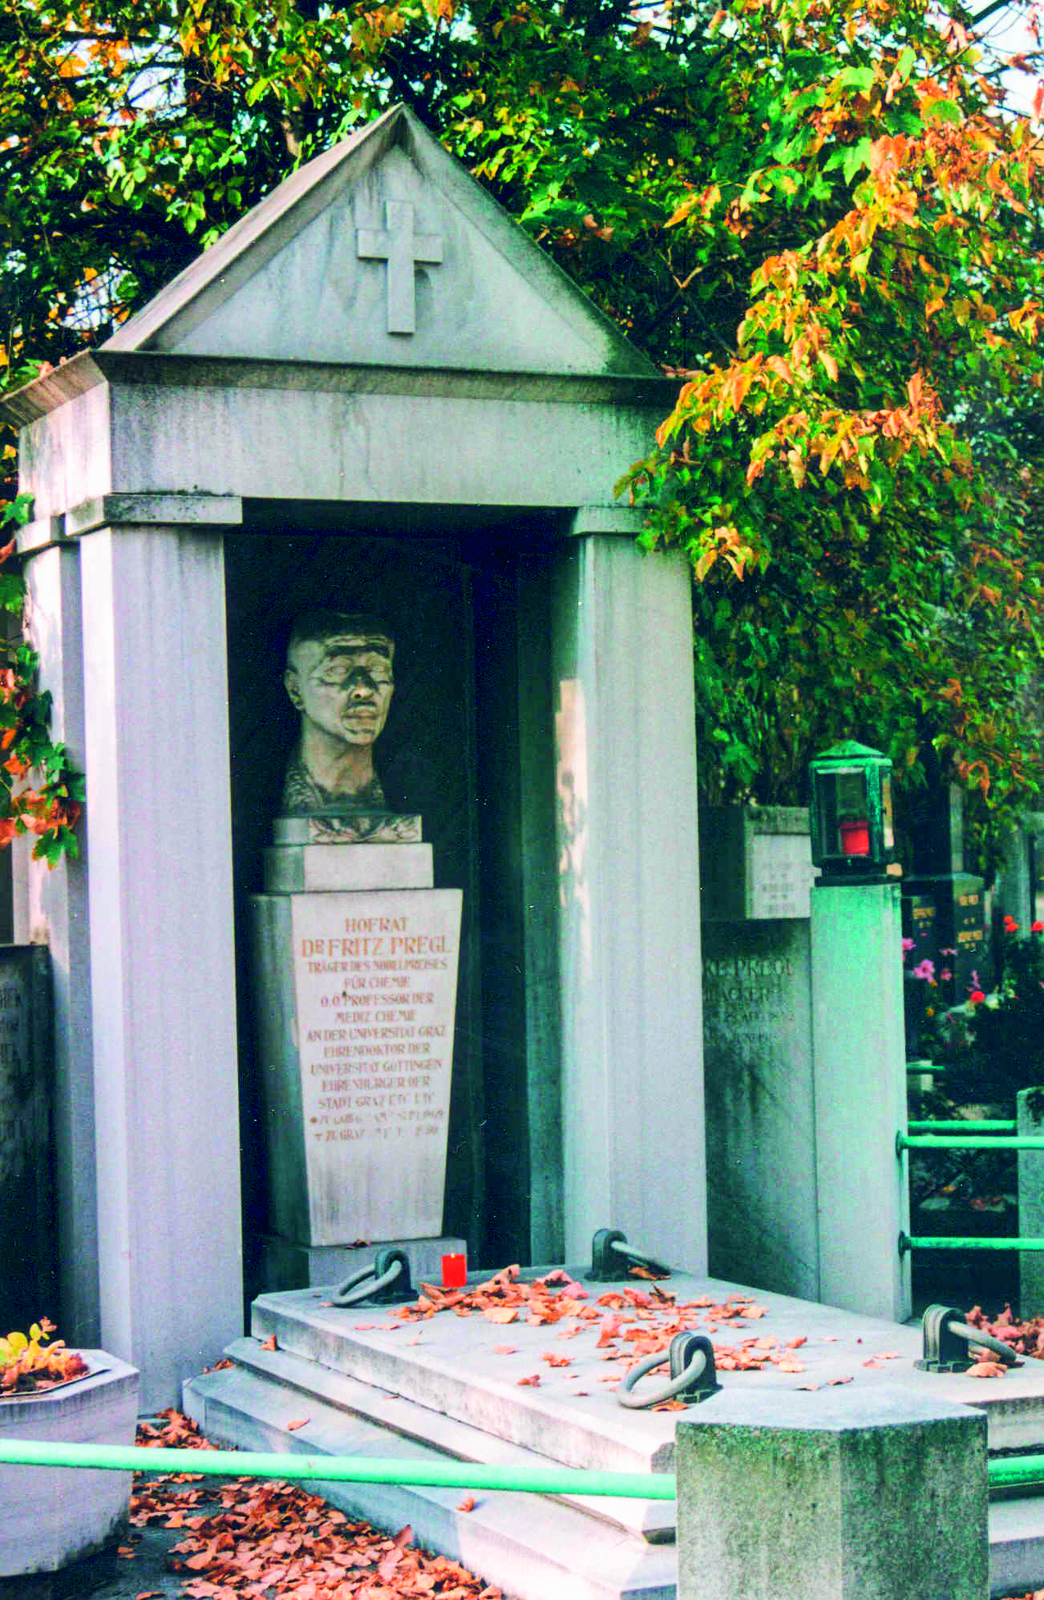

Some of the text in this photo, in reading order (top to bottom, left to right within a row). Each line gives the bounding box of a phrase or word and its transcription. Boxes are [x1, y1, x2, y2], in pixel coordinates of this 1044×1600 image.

[345, 917, 408, 932] HOFRAT
[328, 937, 384, 956] FRITZ
[391, 936, 451, 954] PREGL
